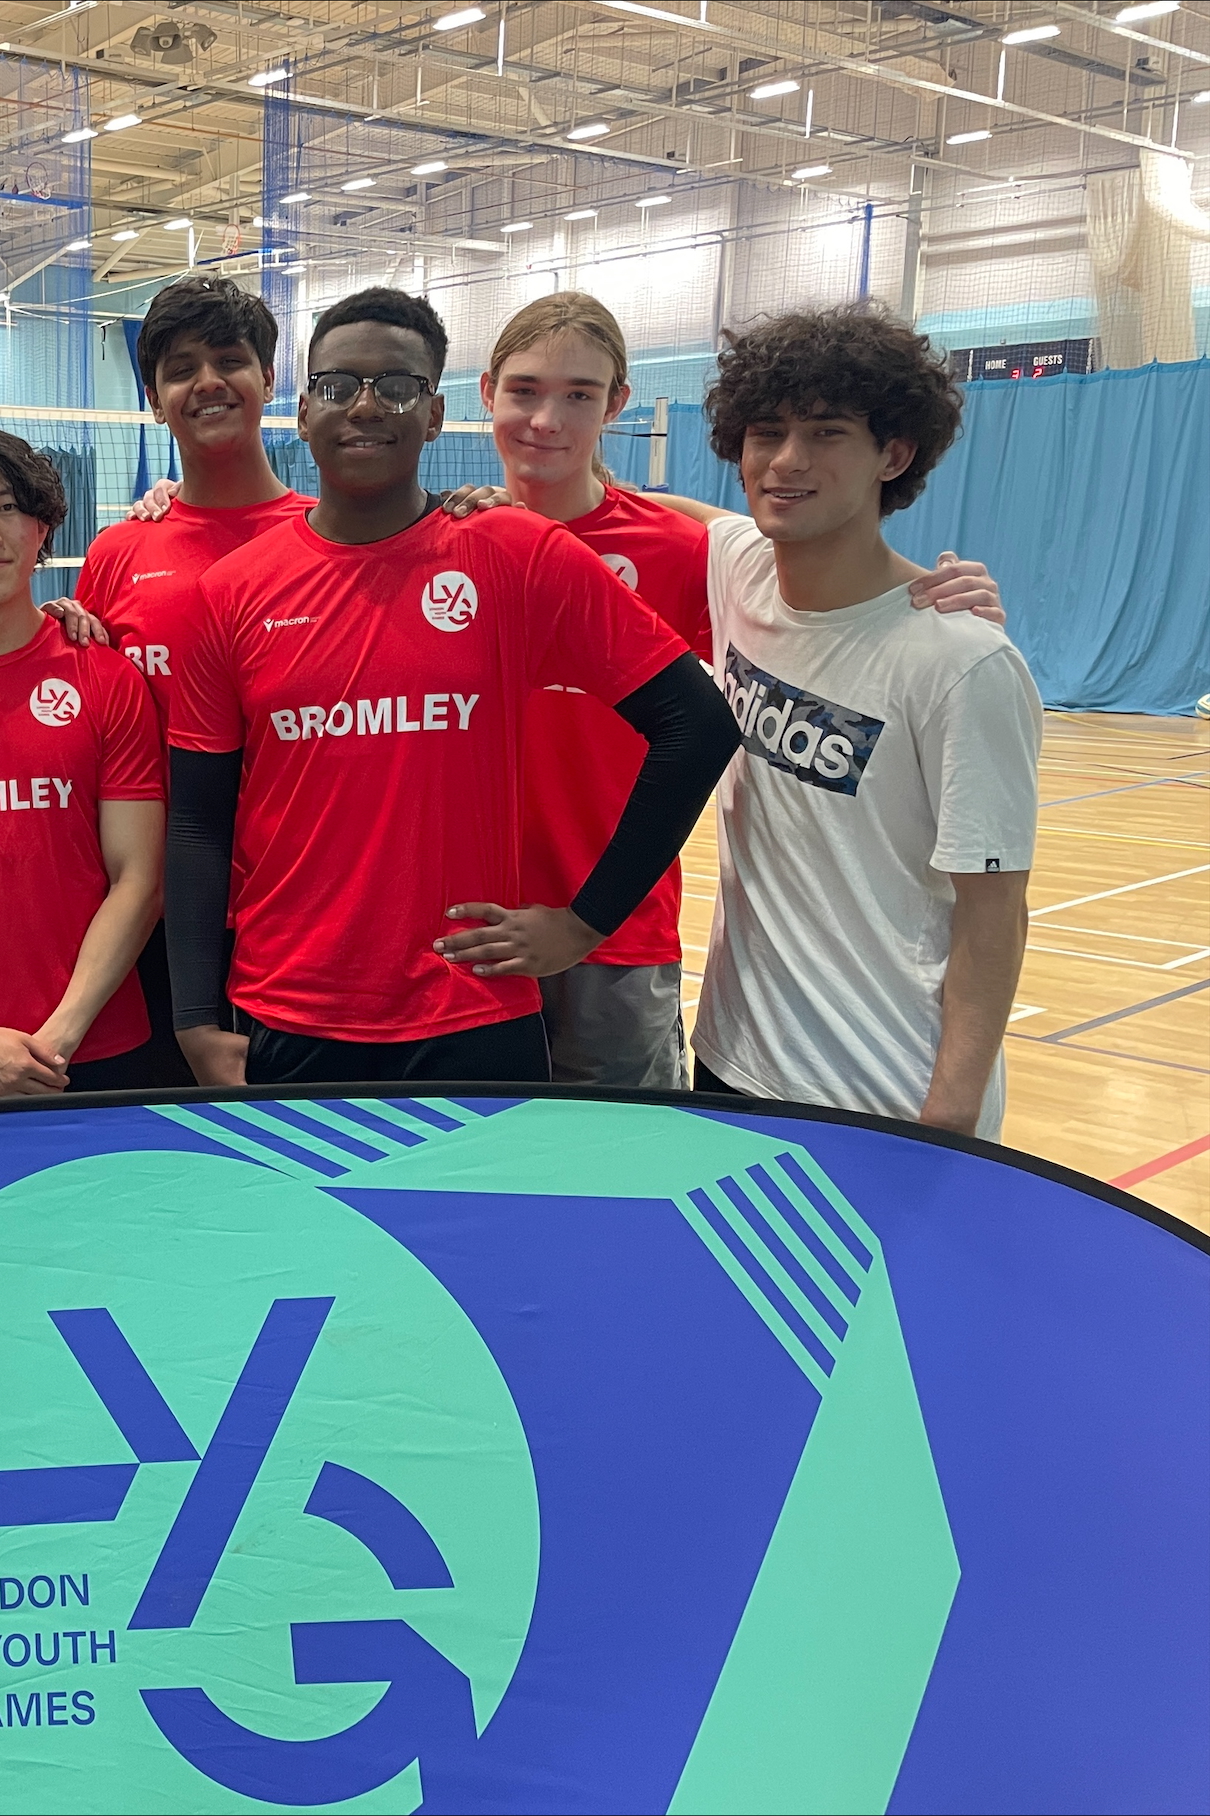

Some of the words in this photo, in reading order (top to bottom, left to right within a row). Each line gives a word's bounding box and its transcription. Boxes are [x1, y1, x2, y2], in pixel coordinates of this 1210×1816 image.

[985, 359, 1007, 370] HOME
[1033, 354, 1063, 366] GUESTS
[139, 570, 167, 580] macron
[274, 616, 310, 628] macron
[270, 693, 480, 741] BROMLEY
